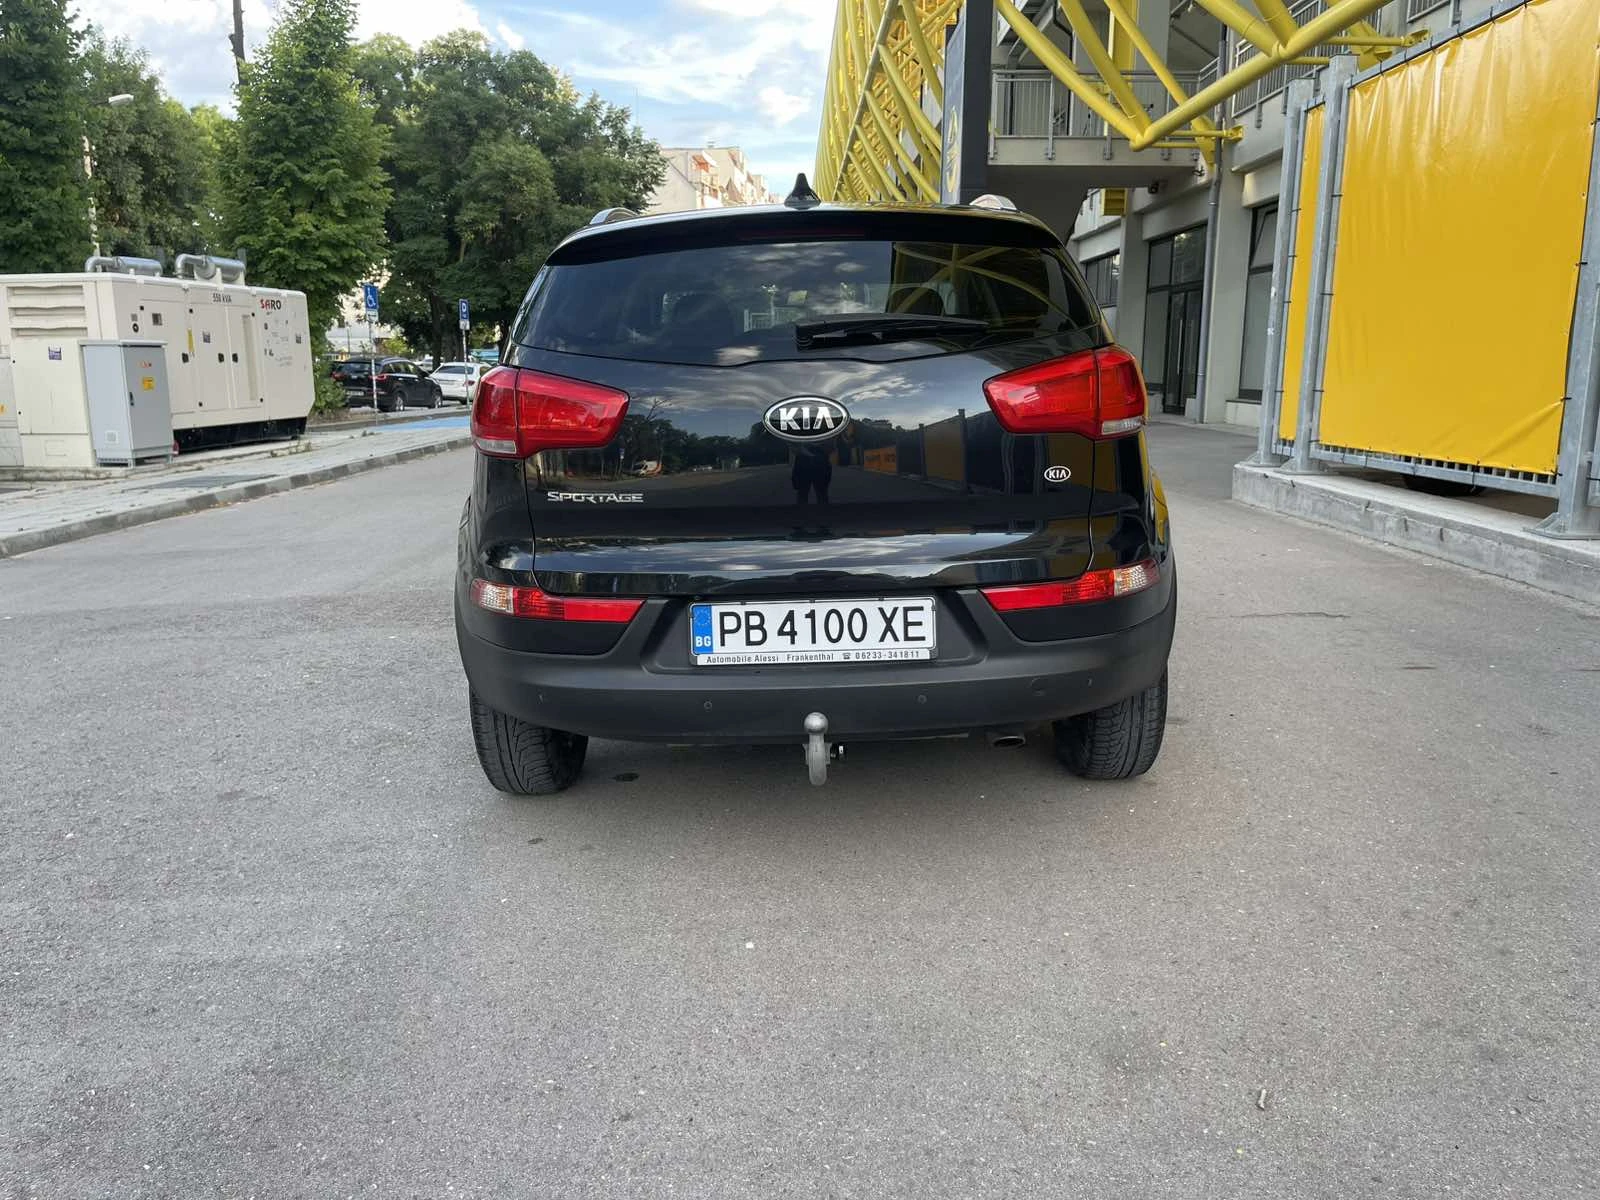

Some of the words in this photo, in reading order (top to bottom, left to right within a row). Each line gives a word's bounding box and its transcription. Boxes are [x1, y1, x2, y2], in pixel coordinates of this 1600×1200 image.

[260, 299, 282, 310] SARO
[779, 406, 835, 431] KIA
[1049, 469, 1067, 479] KIA
[547, 491, 644, 504] SPORTAGE
[718, 610, 768, 647] PB
[777, 607, 868, 645] 4100
[878, 606, 927, 643] XE
[695, 636, 712, 647] BG
[706, 655, 752, 664] Automobile
[754, 654, 779, 663] Alessi
[786, 652, 834, 662] Frankenthal
